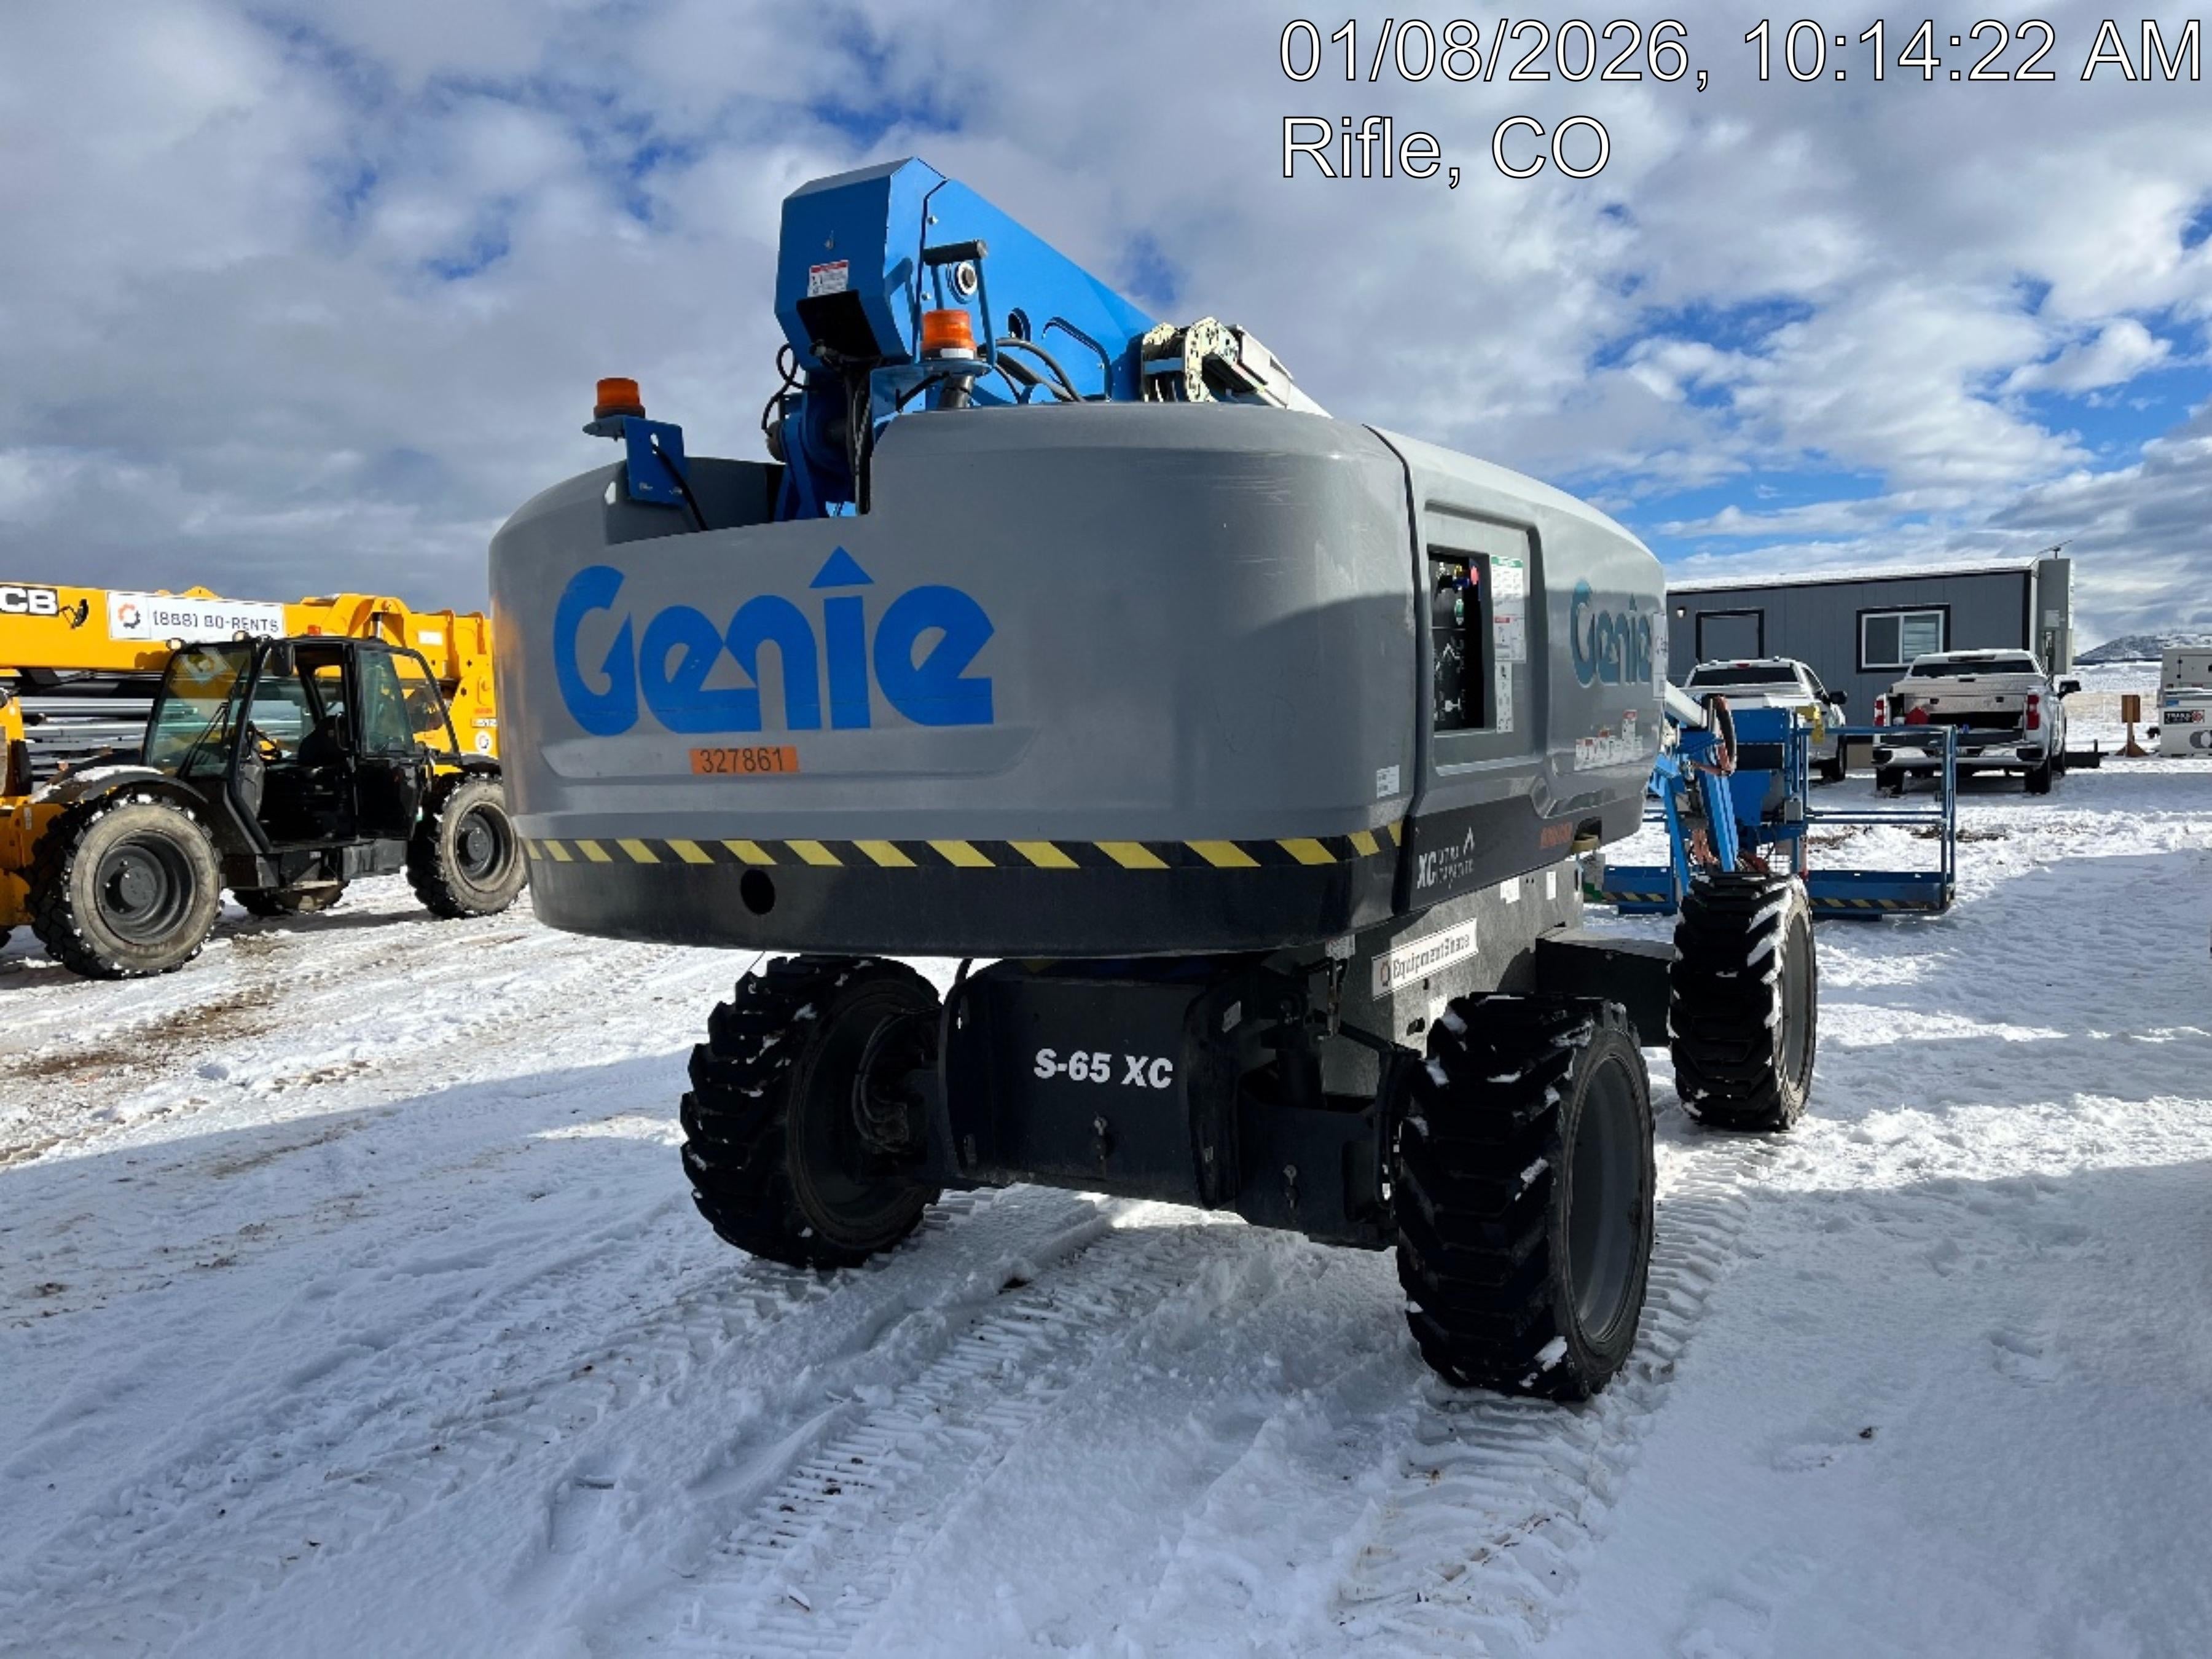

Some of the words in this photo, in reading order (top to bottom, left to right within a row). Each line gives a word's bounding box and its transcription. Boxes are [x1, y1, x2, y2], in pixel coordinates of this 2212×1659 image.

[553, 546, 995, 737] Genie
[1570, 578, 1652, 688] Genie
[700, 747, 783, 773] 327861
[1033, 1048, 1112, 1083] S-65
[1120, 1053, 1174, 1089] XC
